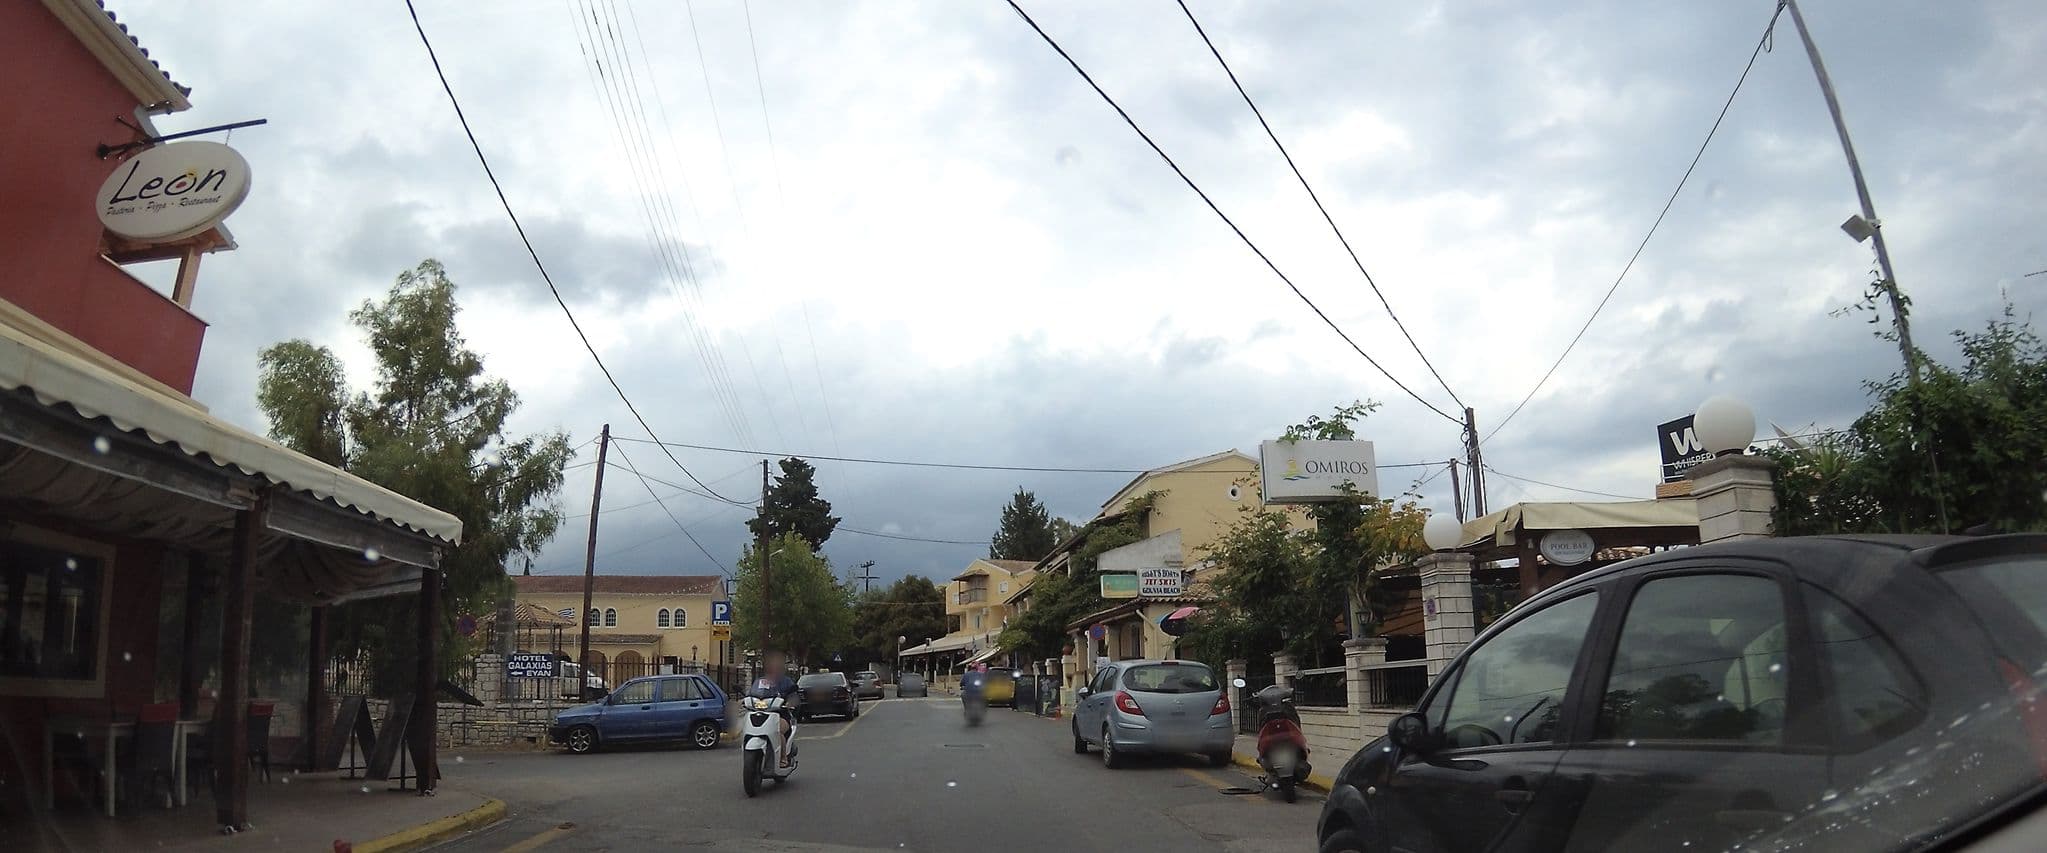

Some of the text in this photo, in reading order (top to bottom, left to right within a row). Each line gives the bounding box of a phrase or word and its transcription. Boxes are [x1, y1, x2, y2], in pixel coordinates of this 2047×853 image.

[109, 159, 227, 205] Leon
[1305, 460, 1369, 475] OMIROS
[715, 603, 728, 620] P
[508, 662, 553, 670] GALAXIAS
